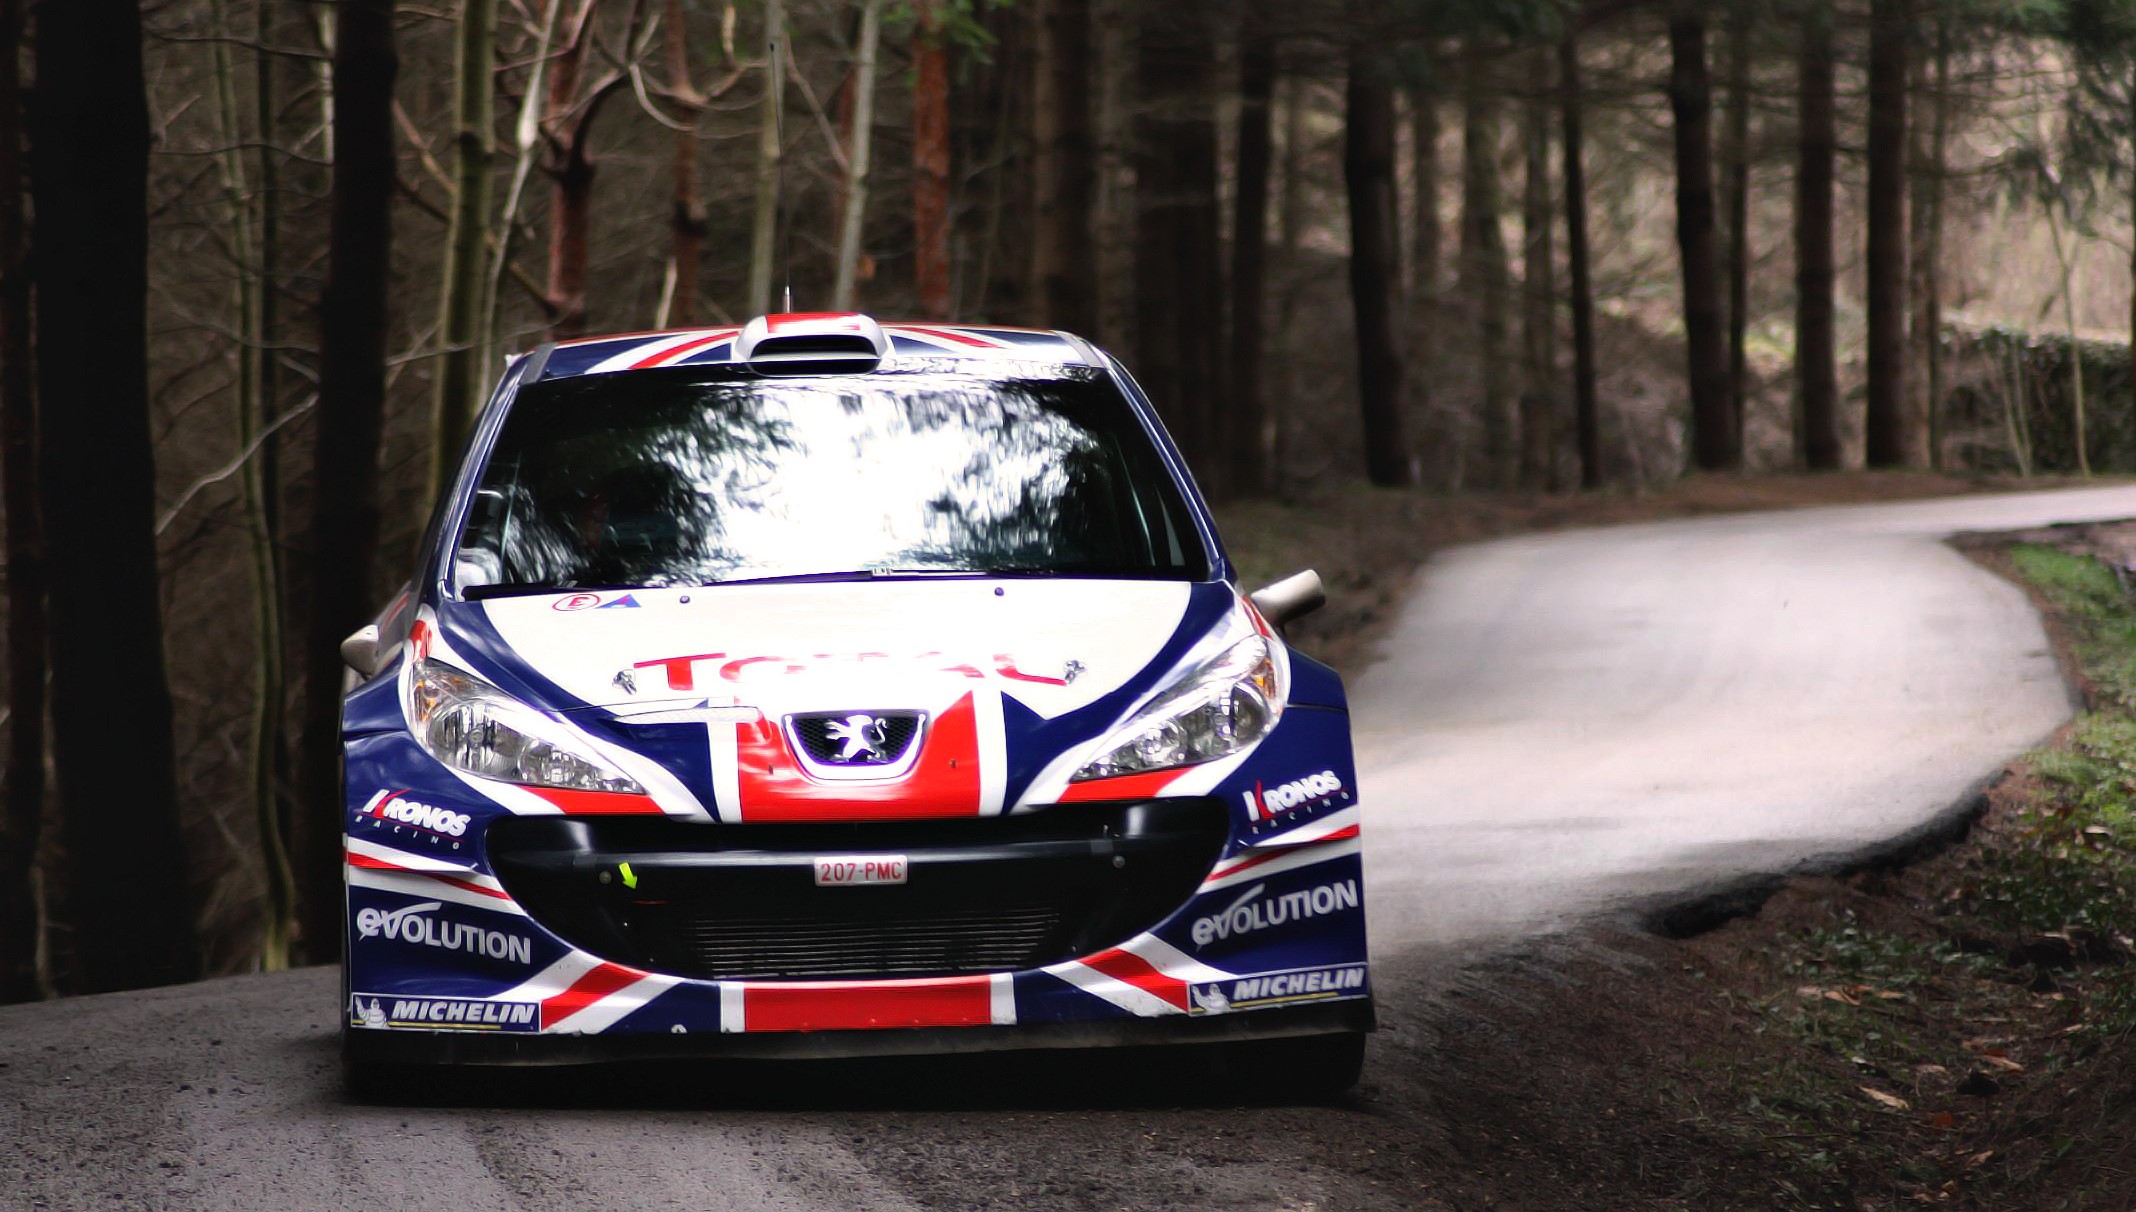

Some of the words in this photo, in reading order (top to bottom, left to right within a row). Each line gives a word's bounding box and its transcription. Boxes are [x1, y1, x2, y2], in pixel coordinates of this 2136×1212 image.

[362, 788, 471, 837] KRONOS
[1242, 769, 1342, 822] KRONOS
[821, 861, 903, 882] 207-PMC
[1233, 967, 1365, 1001] MICHELIN
[391, 999, 534, 1024] MICHELIN
